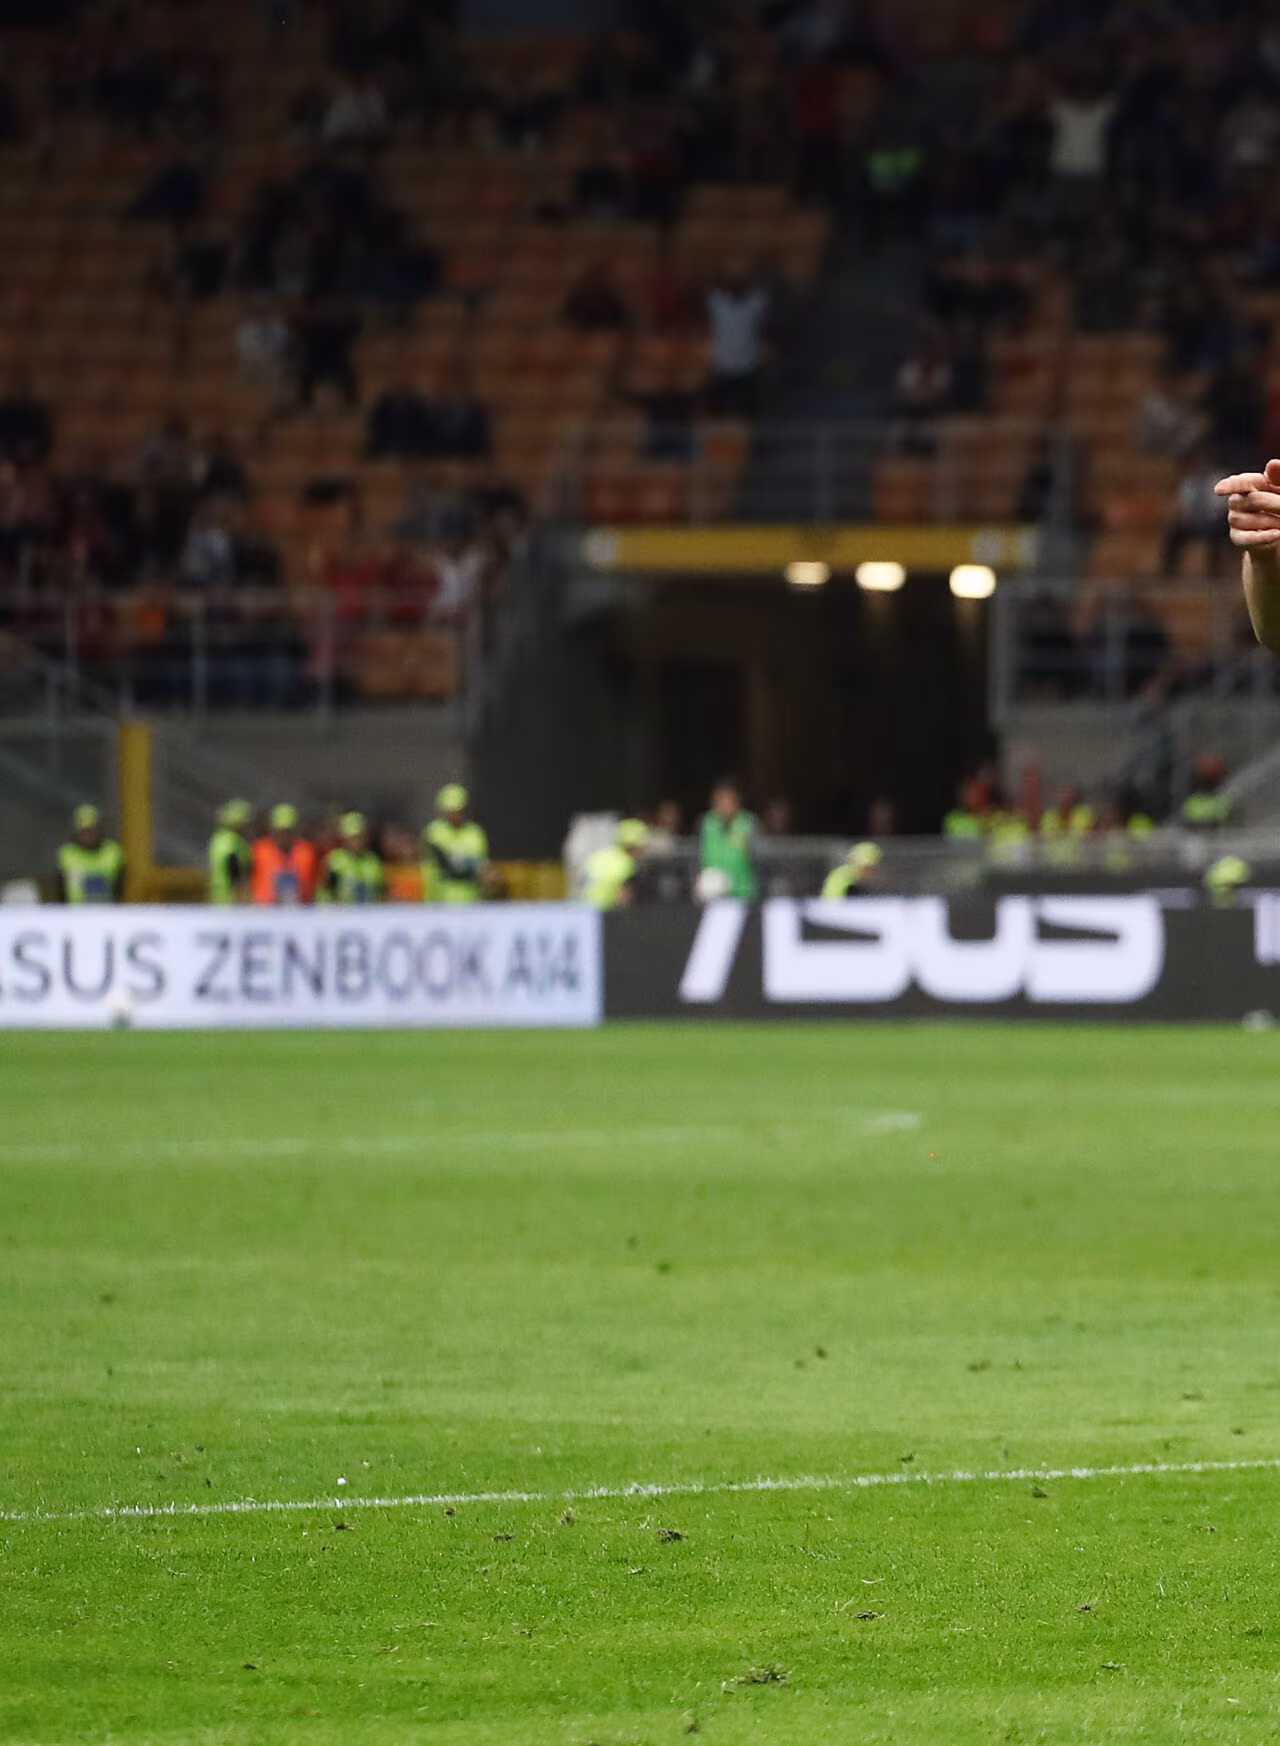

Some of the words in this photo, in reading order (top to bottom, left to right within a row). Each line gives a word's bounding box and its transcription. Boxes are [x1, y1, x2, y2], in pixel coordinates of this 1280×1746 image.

[0, 927, 166, 1001] SUS
[194, 926, 491, 1001] ZENBOOK
[679, 896, 1165, 1002] ASUS
